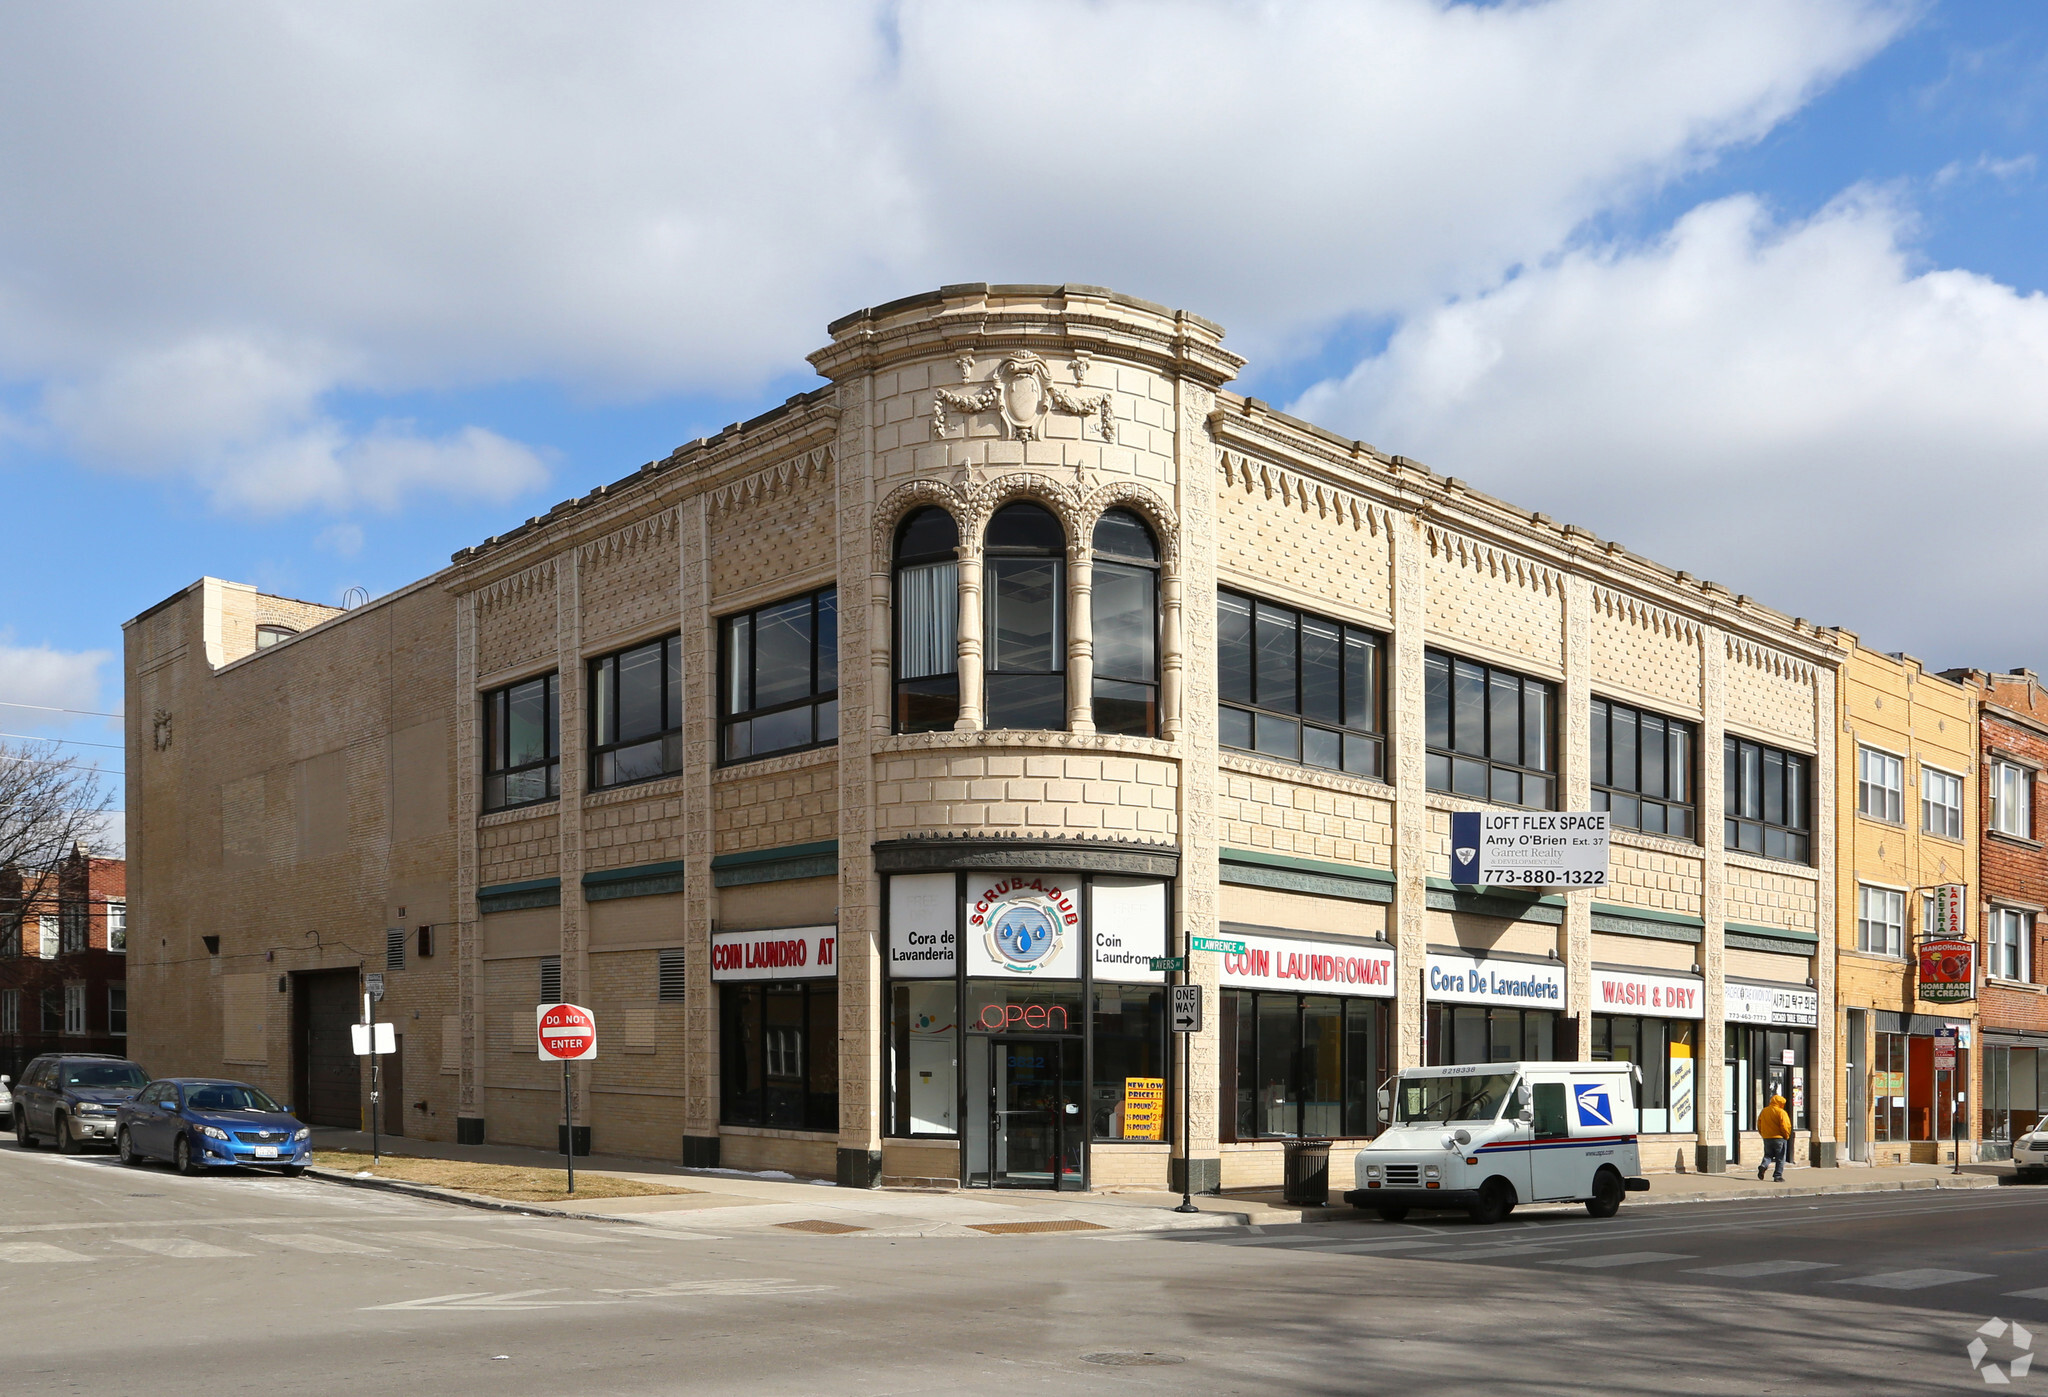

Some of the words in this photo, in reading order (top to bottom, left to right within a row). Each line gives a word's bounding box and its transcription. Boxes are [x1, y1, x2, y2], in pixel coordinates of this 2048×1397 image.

[1486, 816, 1519, 830] LOFT
[1523, 816, 1556, 830] FLEX
[1559, 816, 1605, 830] SPACE
[1486, 835, 1515, 847] Amy
[1519, 835, 1567, 845] O'Brien
[1572, 838, 1590, 846] Ext.
[1593, 838, 1604, 846] 37
[1491, 848, 1528, 858] Garrett
[1531, 848, 1564, 859] Realty
[1484, 870, 1605, 884] 773-880-1322
[1950, 887, 1958, 898] LA
[971, 877, 1079, 926] SCRUB-A-DUB
[1937, 887, 1946, 932] PALETERIA
[1949, 901, 1958, 931] PLAZA
[908, 931, 937, 945] Cora
[940, 930, 955, 944] de
[1096, 933, 1122, 948] Coin
[1200, 940, 1237, 952] LAWRENCE
[712, 944, 742, 971] COIN
[892, 947, 954, 961] Lavanderia
[1155, 959, 1175, 970] AVERS
[1225, 948, 1269, 977] COIN
[1277, 951, 1390, 985] LAUNDROMAT
[1431, 965, 1464, 992] Cora
[1469, 969, 1487, 994] De
[1491, 971, 1558, 999] Lavanderia
[1175, 989, 1195, 1000] ONE
[1602, 981, 1646, 1006] WASH
[1653, 986, 1661, 1007] &
[1666, 987, 1695, 1009] DRY
[1773, 993, 1790, 1009] 시카고
[1175, 1002, 1195, 1013] WAY
[546, 1016, 559, 1024] DO
[565, 1015, 585, 1024] NOT
[551, 1040, 583, 1049] ENTER
